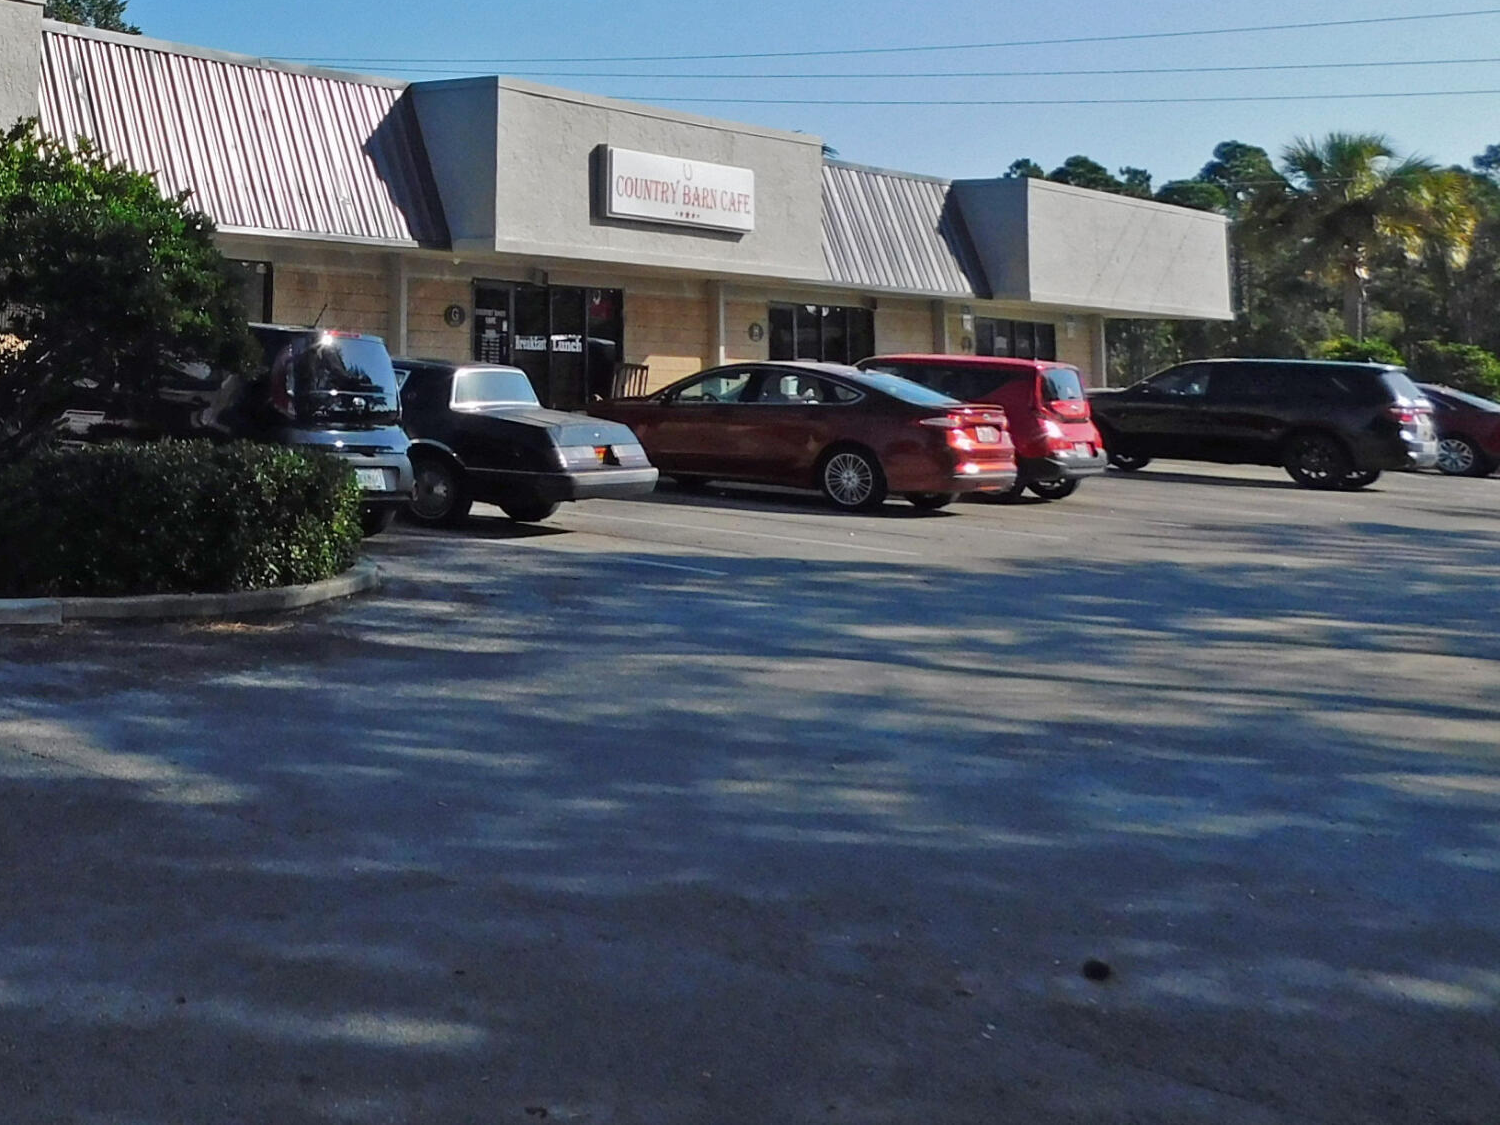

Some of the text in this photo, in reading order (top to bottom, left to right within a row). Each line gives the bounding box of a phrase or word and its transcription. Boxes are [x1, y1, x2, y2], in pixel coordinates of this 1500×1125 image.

[616, 175, 750, 214] COUNTRY BARN CAFE
[551, 337, 583, 352] Lunch
